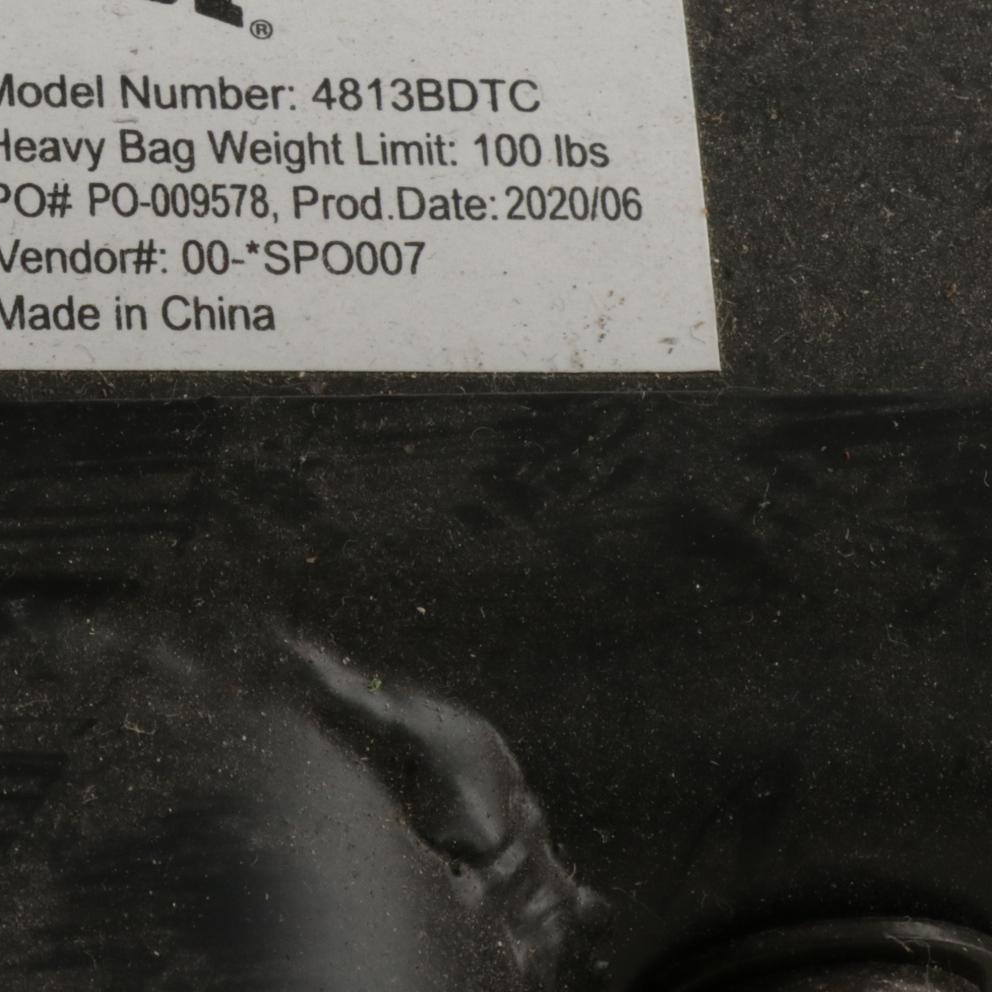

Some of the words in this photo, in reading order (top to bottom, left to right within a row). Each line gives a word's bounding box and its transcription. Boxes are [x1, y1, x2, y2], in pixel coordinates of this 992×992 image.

[120, 74, 296, 111] Number:
[311, 77, 540, 113] 4813BDTC
[119, 128, 196, 174] Bag
[207, 130, 344, 174] Weight
[355, 131, 457, 166] Limit:
[474, 133, 542, 167] 100
[554, 134, 610, 168] lbs
[88, 182, 279, 224] PO-009578,
[504, 185, 643, 222] 2020/06
[114, 295, 148, 331] in
[161, 294, 276, 332] China
